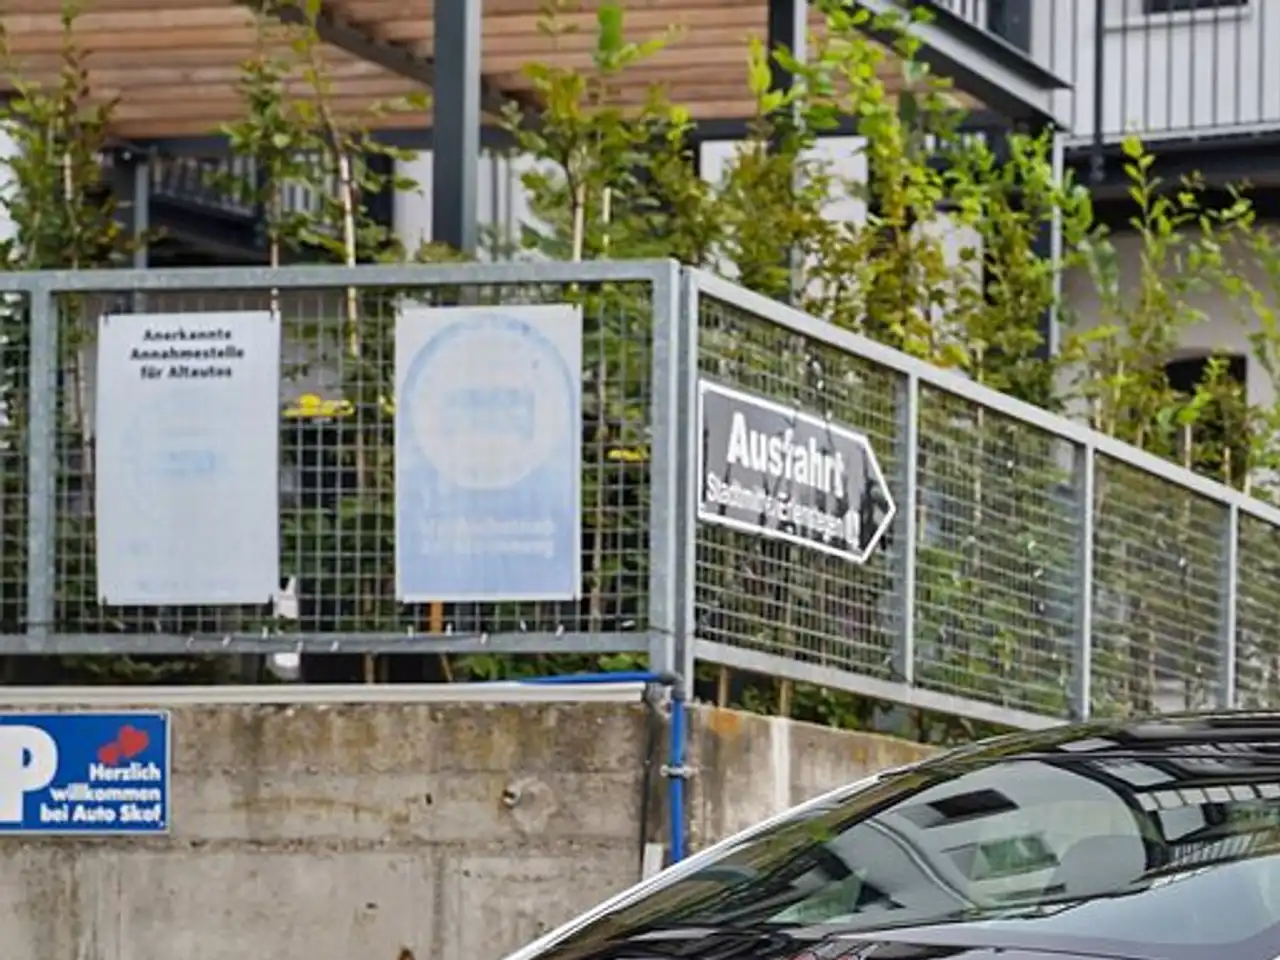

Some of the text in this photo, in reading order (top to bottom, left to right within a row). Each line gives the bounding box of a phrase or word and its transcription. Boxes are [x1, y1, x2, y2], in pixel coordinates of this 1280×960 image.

[143, 327, 232, 341] Anerkannte
[130, 345, 245, 361] Annahmestelle
[140, 365, 163, 379] für
[727, 411, 845, 498] Ausfahrt
[0, 724, 58, 822] P
[89, 762, 162, 781] Herzlich
[50, 783, 162, 801] willkommen
[40, 802, 69, 822] bei
[72, 804, 117, 822] Auto
